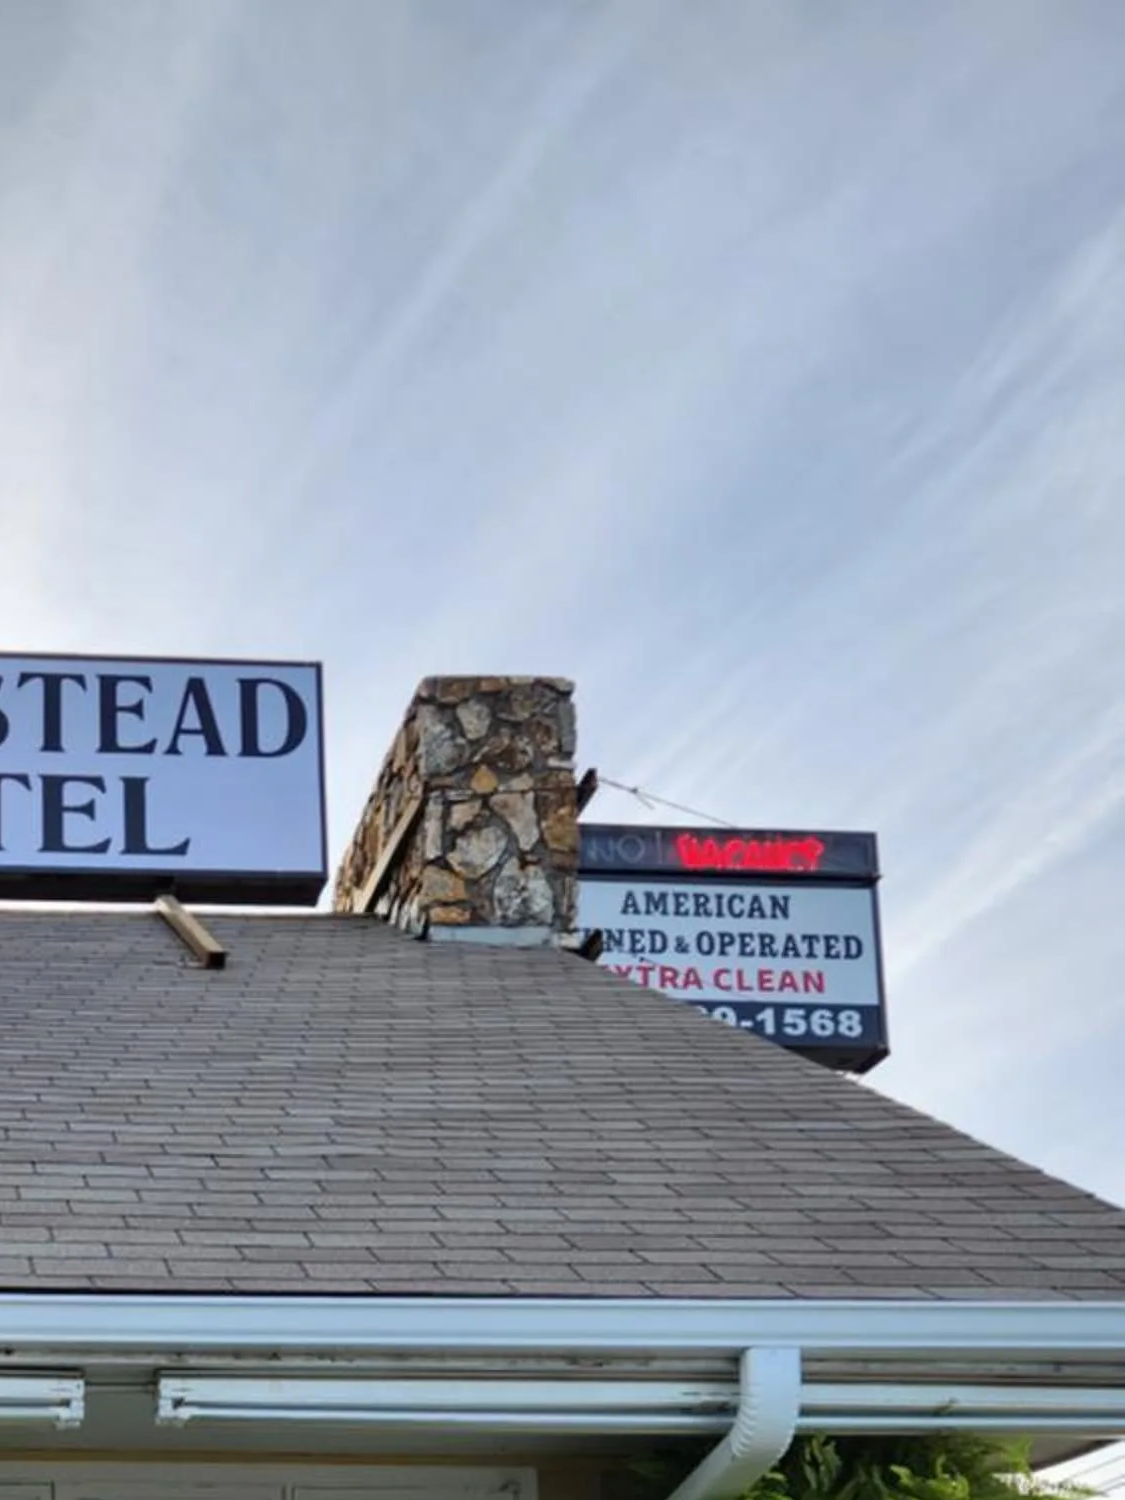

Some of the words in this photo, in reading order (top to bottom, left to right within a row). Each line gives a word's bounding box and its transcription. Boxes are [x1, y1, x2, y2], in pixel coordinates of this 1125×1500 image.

[620, 890, 791, 920] AMERICAN
[577, 927, 668, 955] NED
[675, 935, 691, 954] &
[695, 930, 863, 960] OPERATED
[713, 967, 825, 993] CLEAN
